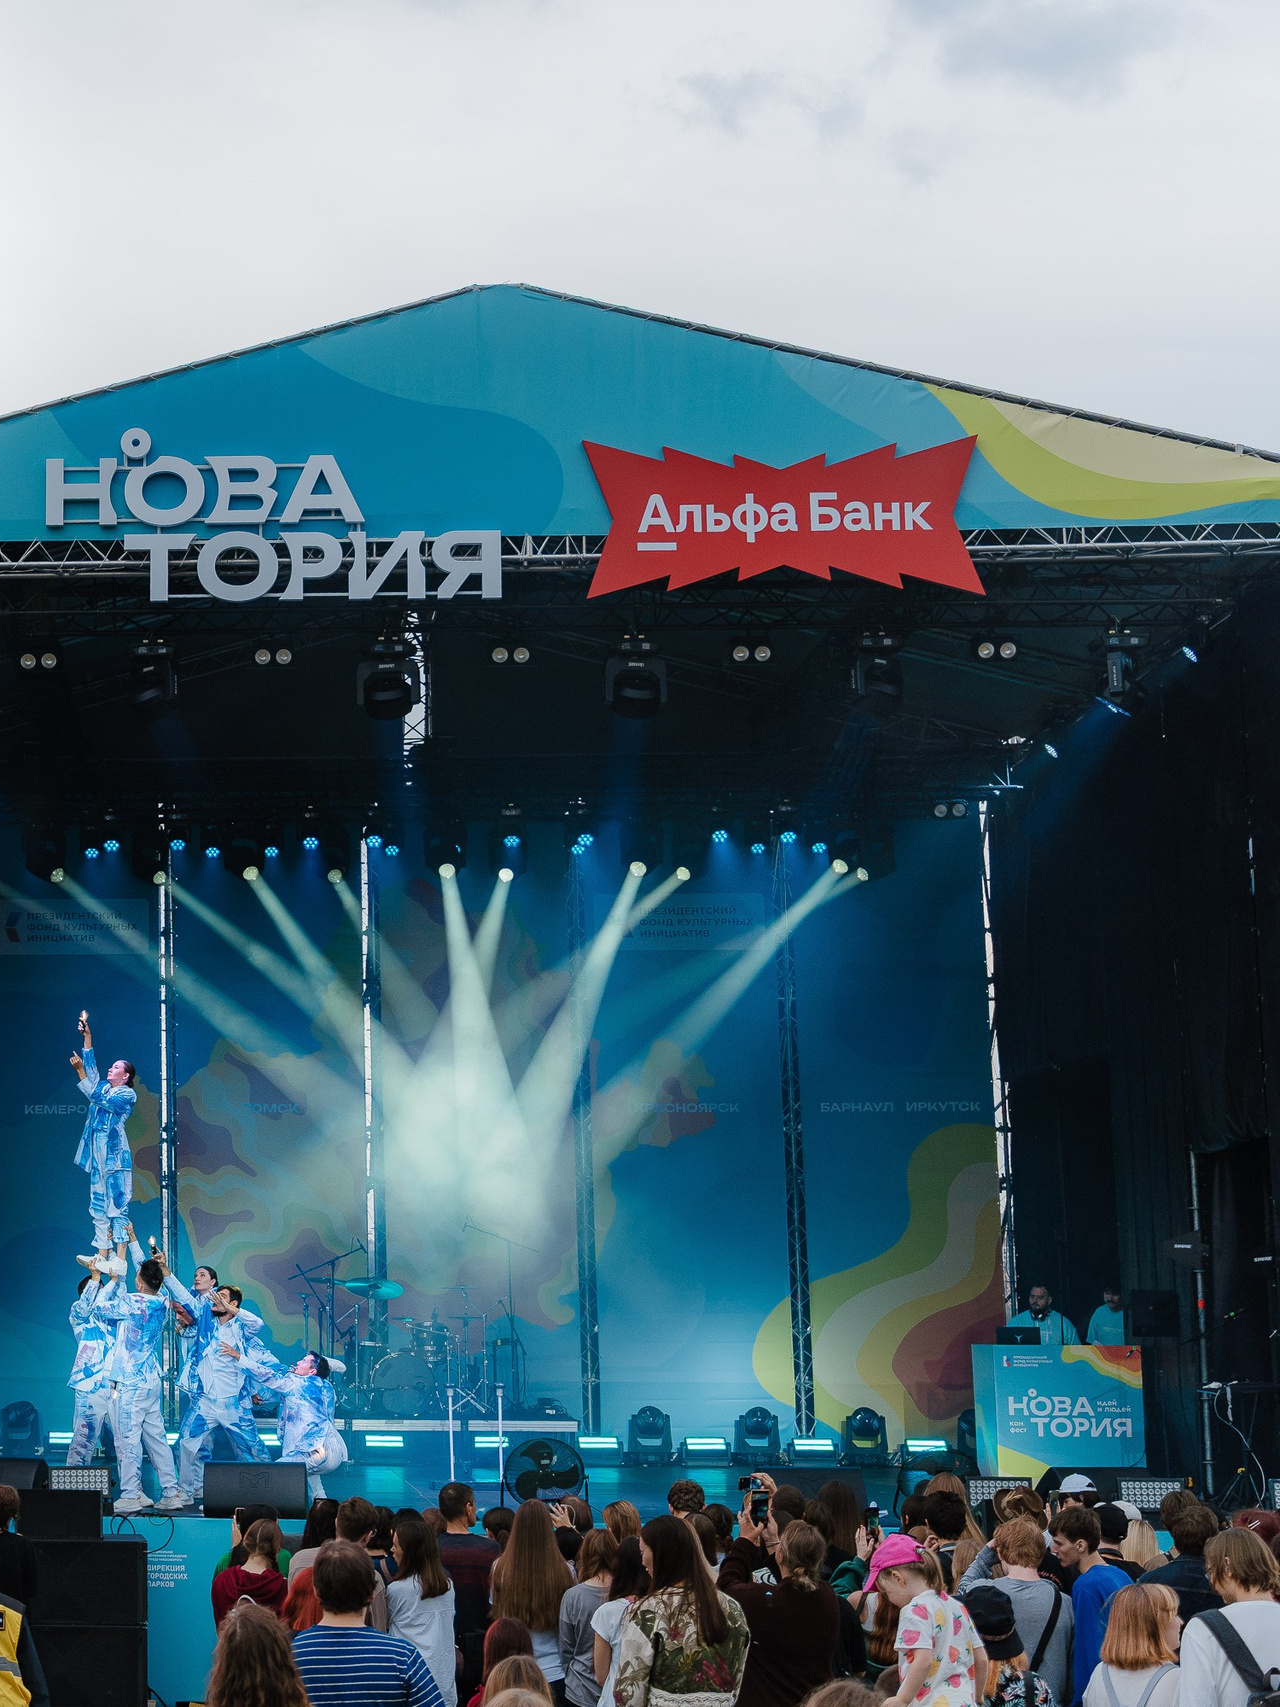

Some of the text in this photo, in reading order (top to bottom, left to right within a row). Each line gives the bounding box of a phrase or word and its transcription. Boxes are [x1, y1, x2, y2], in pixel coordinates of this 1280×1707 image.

[46, 447, 365, 527] НОВА
[637, 492, 933, 543] Альфа Банк
[124, 529, 502, 602] ТОРИЯ
[26, 910, 122, 921] ПРЕЗИДЕНТСКИЙ
[26, 923, 137, 933] ФОНД КУЛЬТУРНЫХ
[640, 918, 754, 927] ФОНД КУЛЬТУРНЫХ
[27, 934, 95, 943] ИНИЦИАТИВ
[24, 1104, 88, 1115] КЕМЕРО
[243, 1103, 300, 1114] ТОМСК
[820, 1102, 894, 1112] БАРНАУЛ
[906, 1101, 981, 1112] ИРКУТСК
[1008, 1393, 1095, 1417] НОВА
[1030, 1417, 1133, 1438] ТОРИЯ
[147, 1564, 186, 1572] ДИРЕКЦИЯ
